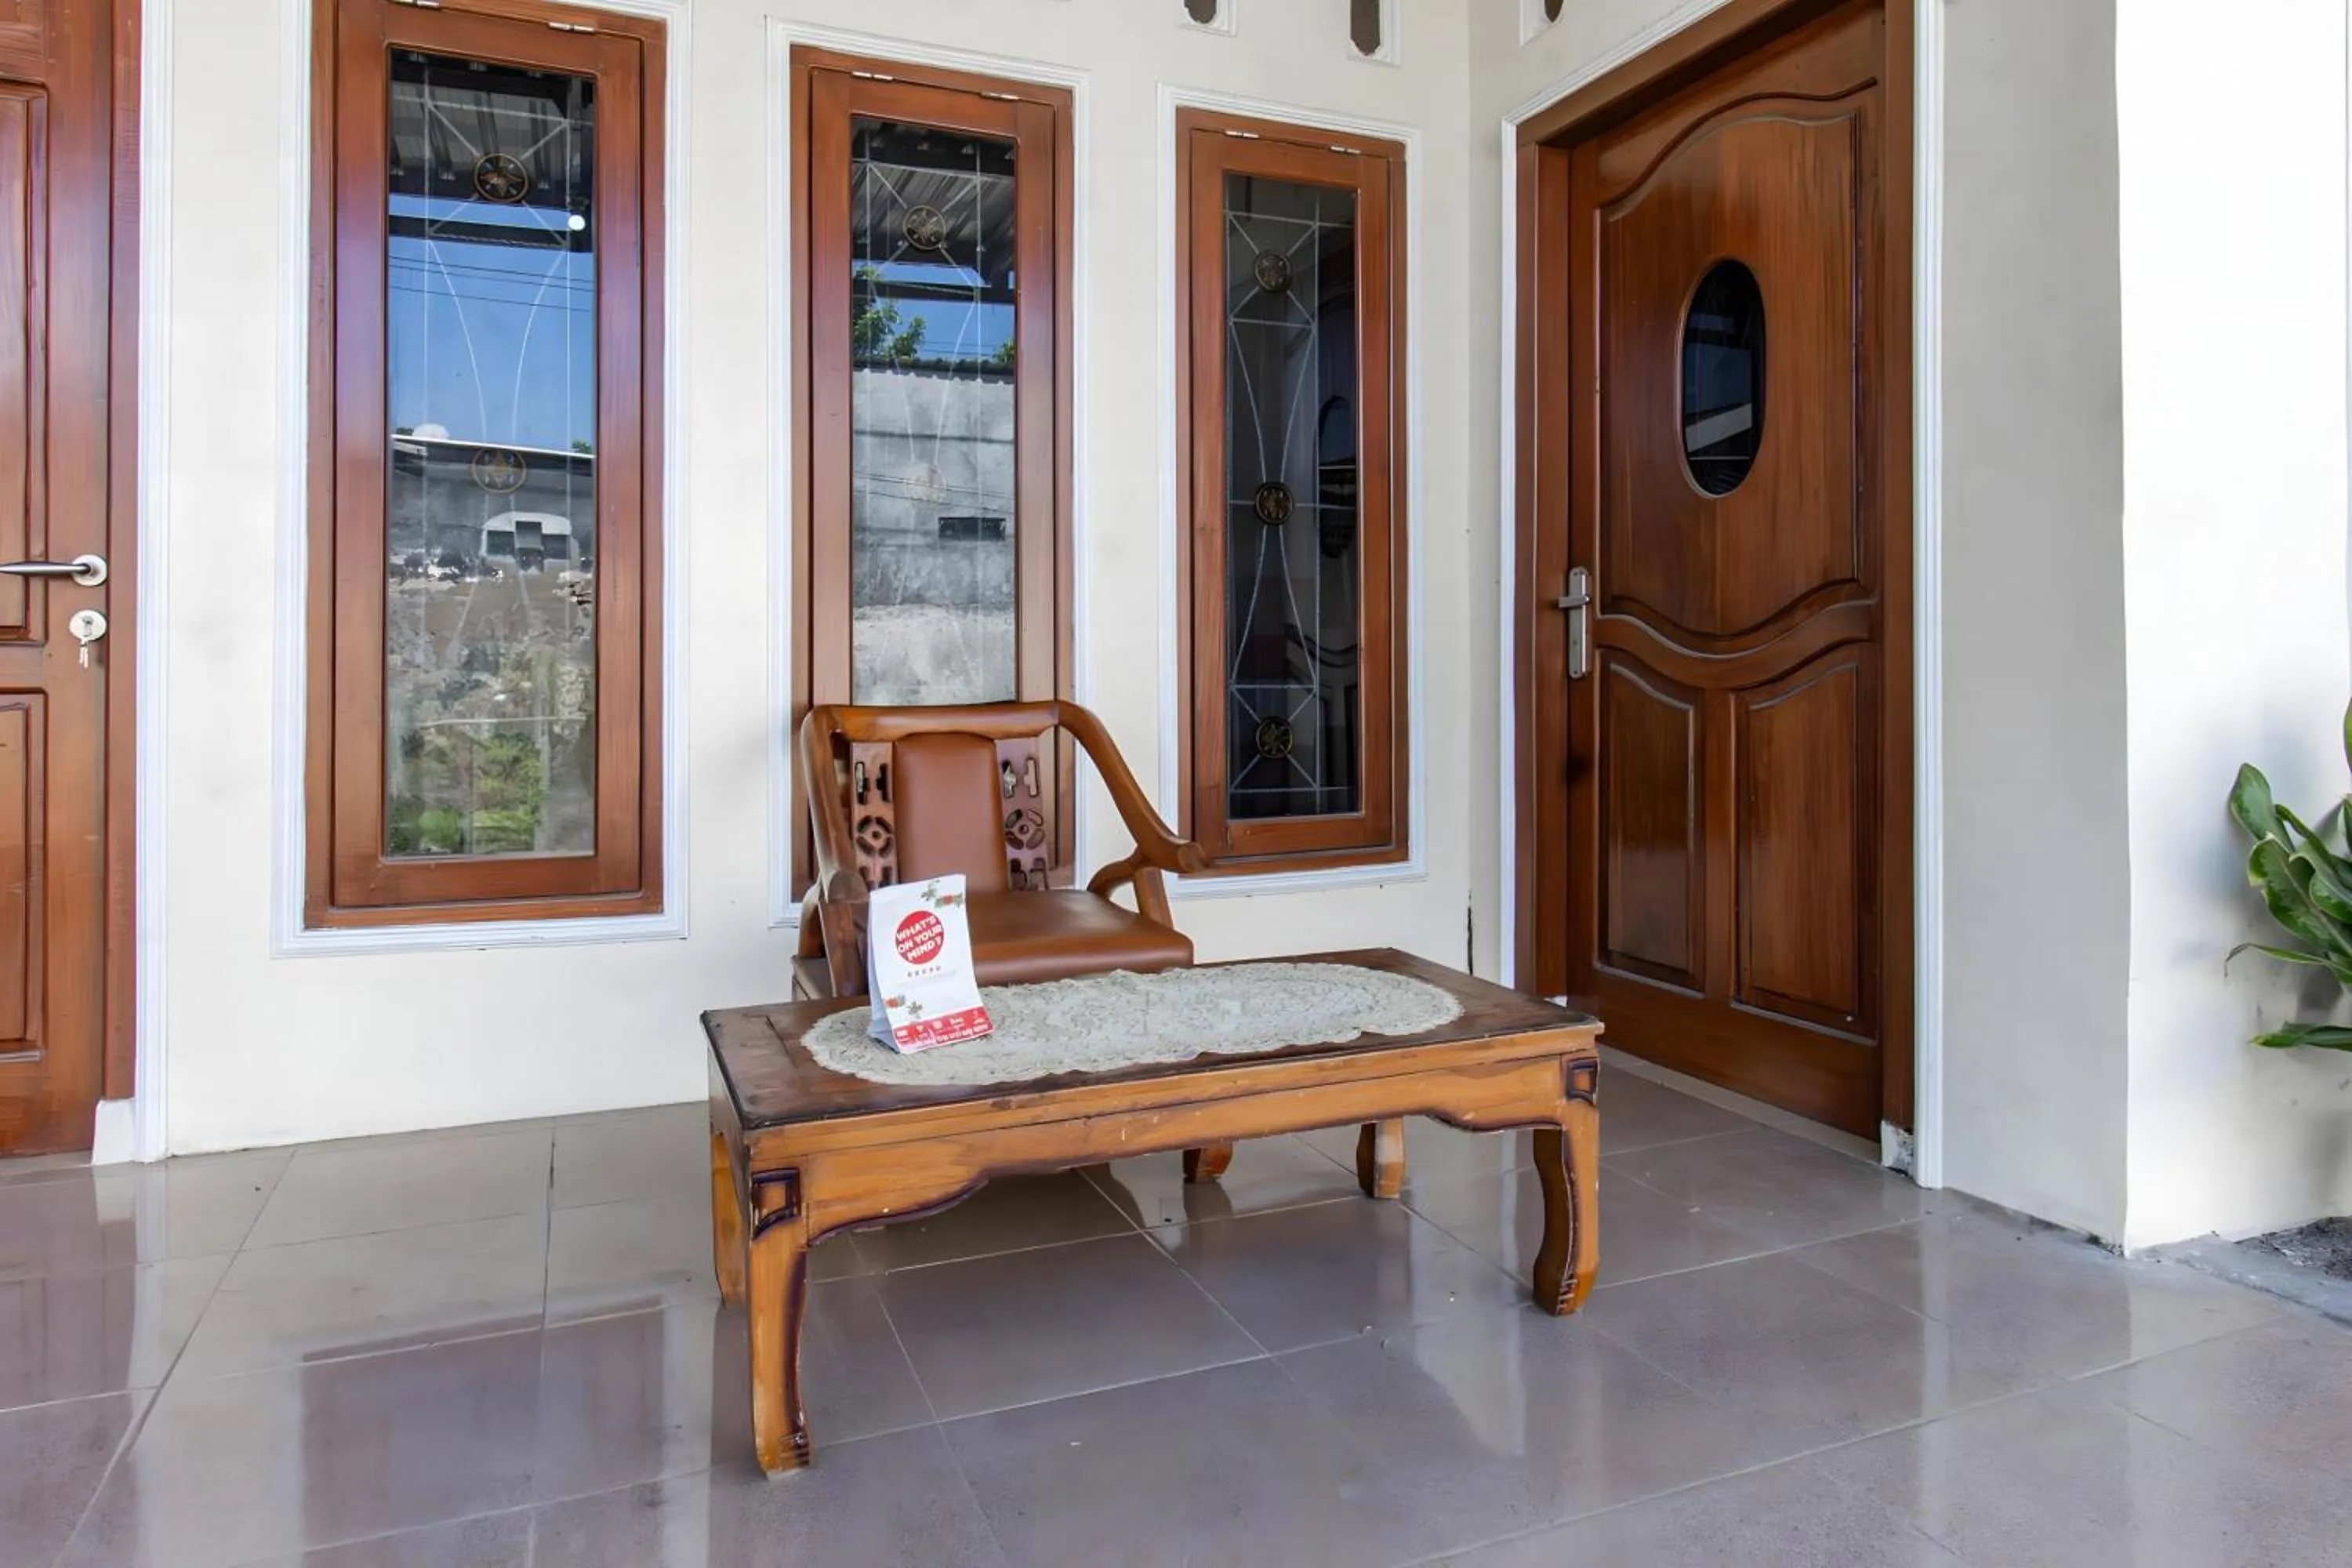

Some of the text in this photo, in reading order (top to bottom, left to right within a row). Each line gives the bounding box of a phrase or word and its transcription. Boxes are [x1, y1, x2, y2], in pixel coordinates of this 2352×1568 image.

[896, 916, 937, 941] WHAT'S
[898, 924, 942, 953] ON YOUR
